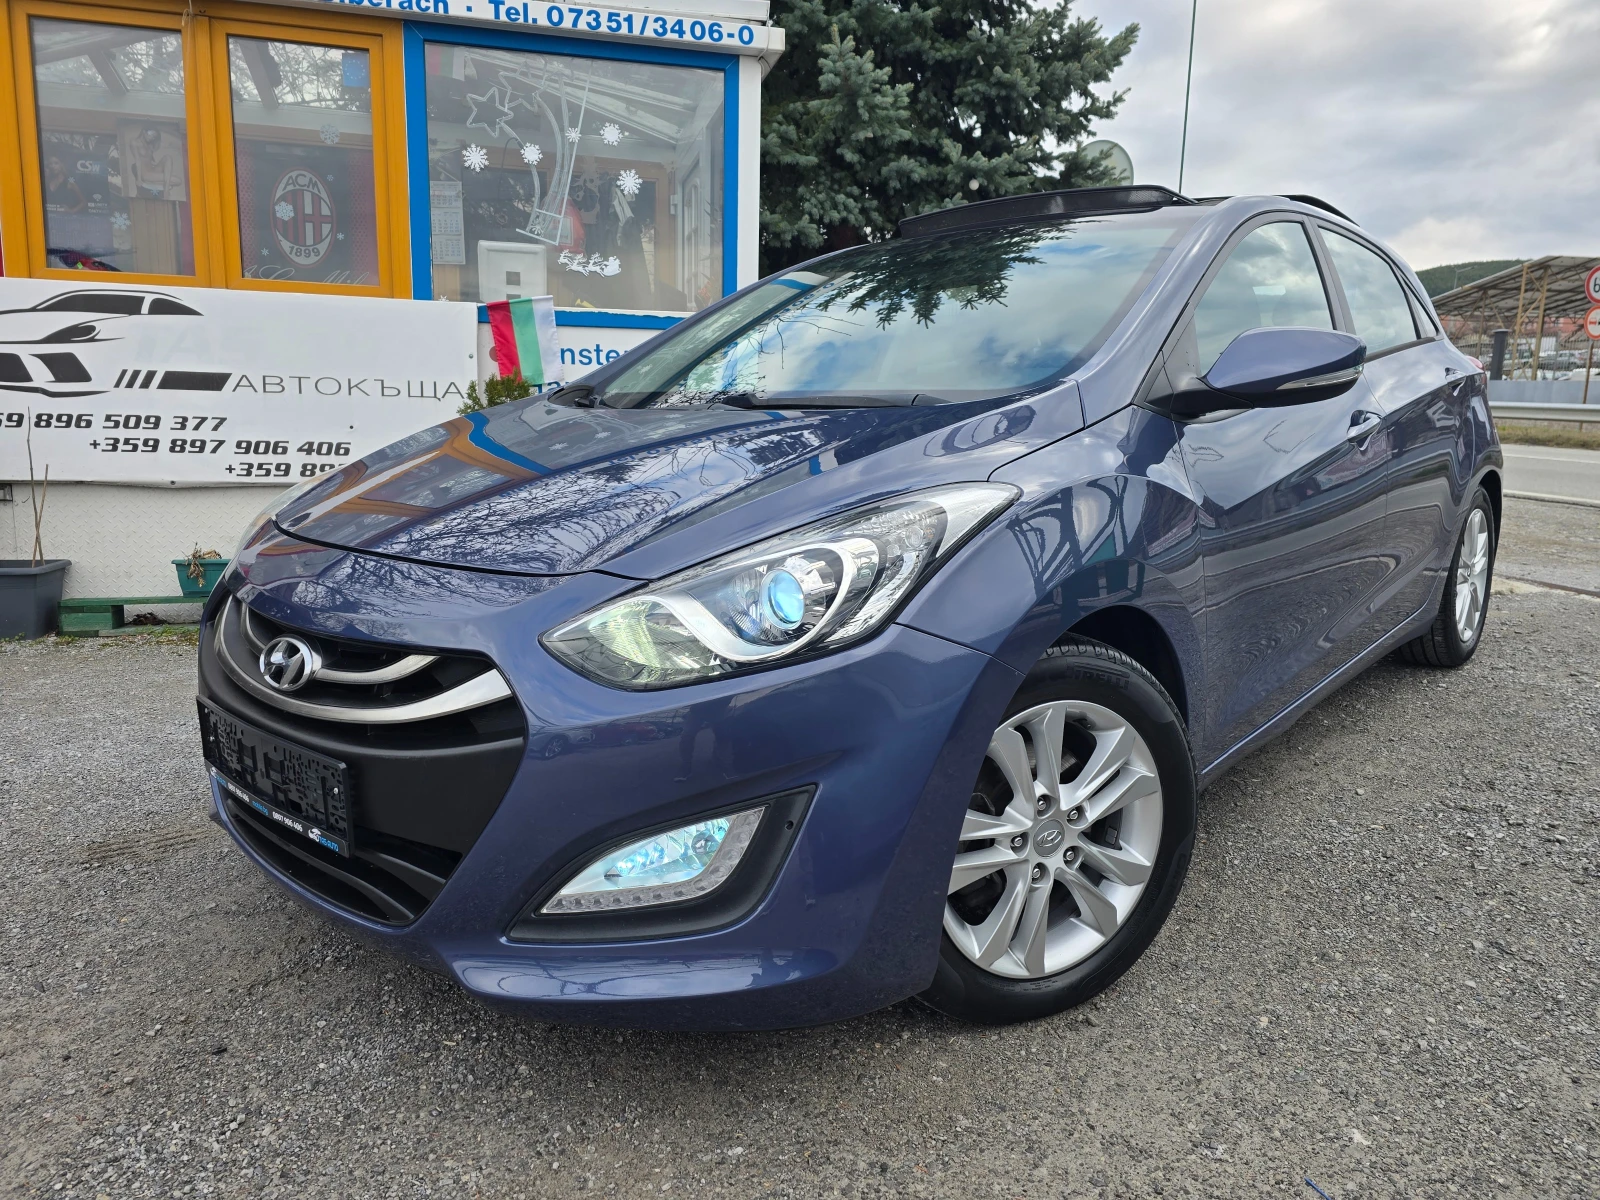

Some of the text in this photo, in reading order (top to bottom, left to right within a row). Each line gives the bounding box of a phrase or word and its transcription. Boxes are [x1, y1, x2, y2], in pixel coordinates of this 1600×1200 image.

[488, 1, 538, 24] Tel.
[546, 5, 754, 46] 07351/3406-0
[281, 173, 322, 195] ACM
[288, 245, 321, 259] 1899
[560, 343, 630, 366] nste
[231, 374, 465, 401] АВТОКЪЩА
[33, 412, 94, 429] 896
[102, 413, 162, 430] 509
[170, 415, 228, 431] 377
[89, 437, 351, 456] +359 897 906 406
[225, 462, 346, 478] +359 89
